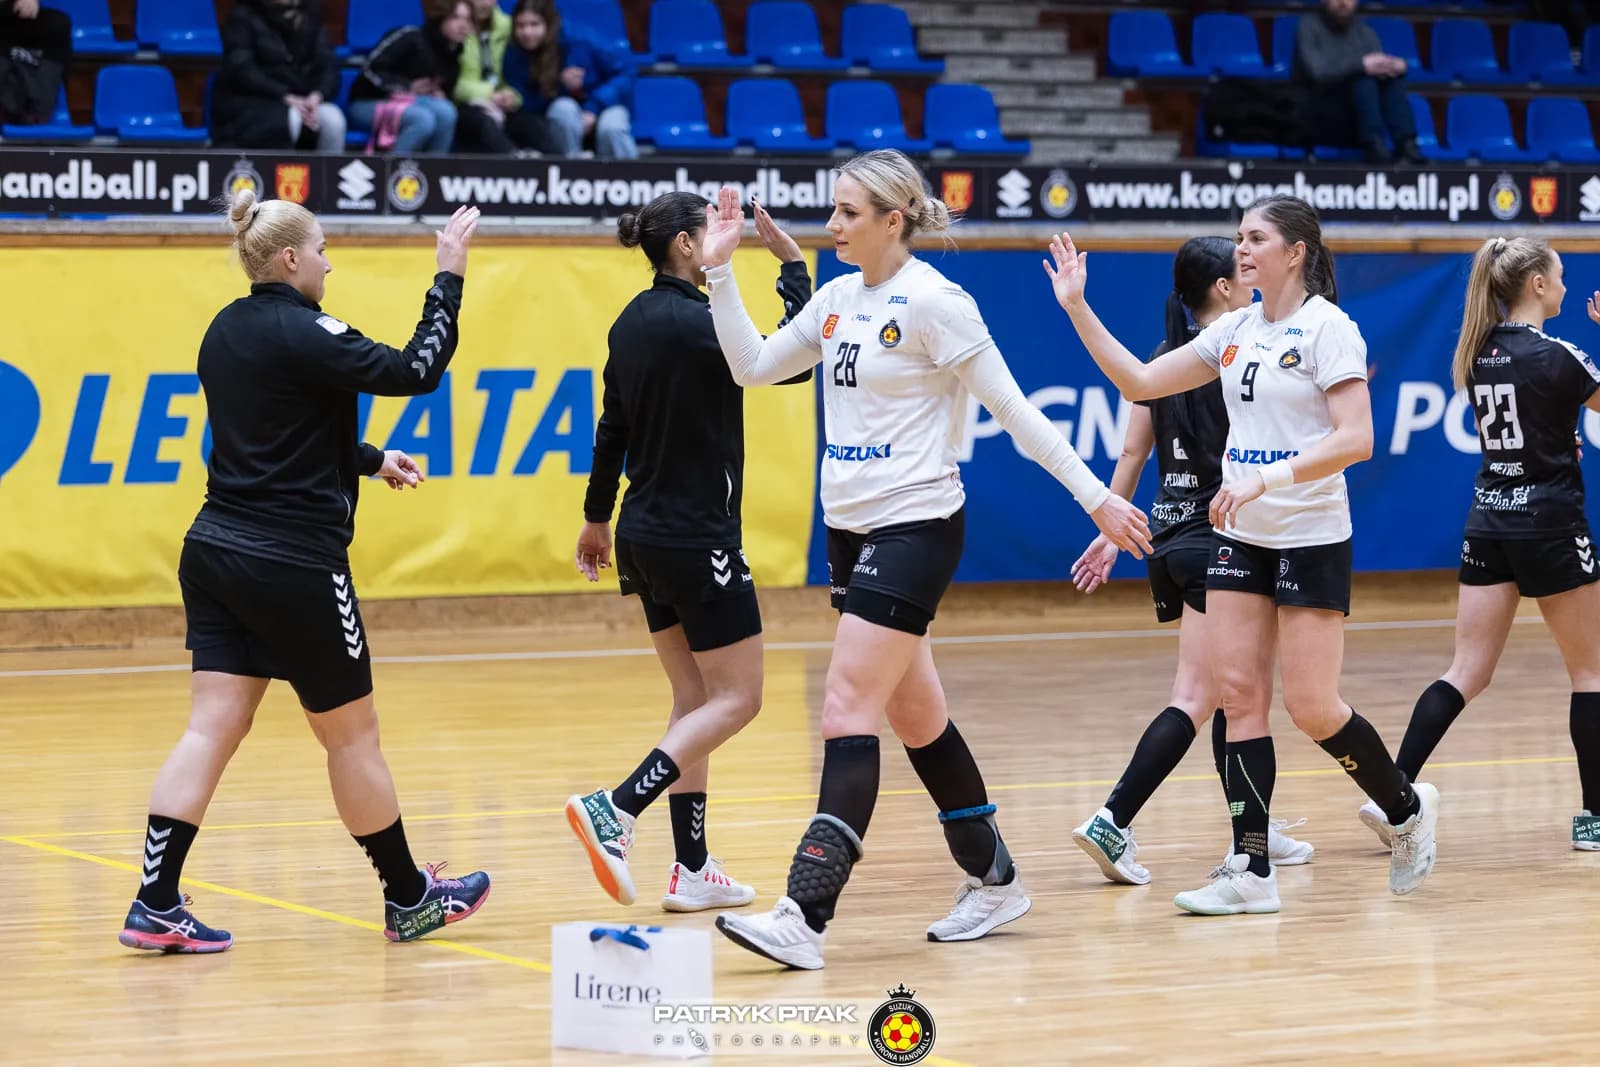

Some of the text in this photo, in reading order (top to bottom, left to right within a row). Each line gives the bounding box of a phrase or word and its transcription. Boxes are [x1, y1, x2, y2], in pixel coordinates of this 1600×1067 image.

[0, 159, 209, 213] andball.pl
[833, 342, 861, 388] 28
[1240, 362, 1260, 402] 9
[57, 368, 628, 486] LEATA
[1474, 384, 1523, 450] 23
[827, 444, 891, 461] SUZUKI
[1229, 447, 1299, 464] SUZUK
[575, 972, 662, 1004] Lirene
